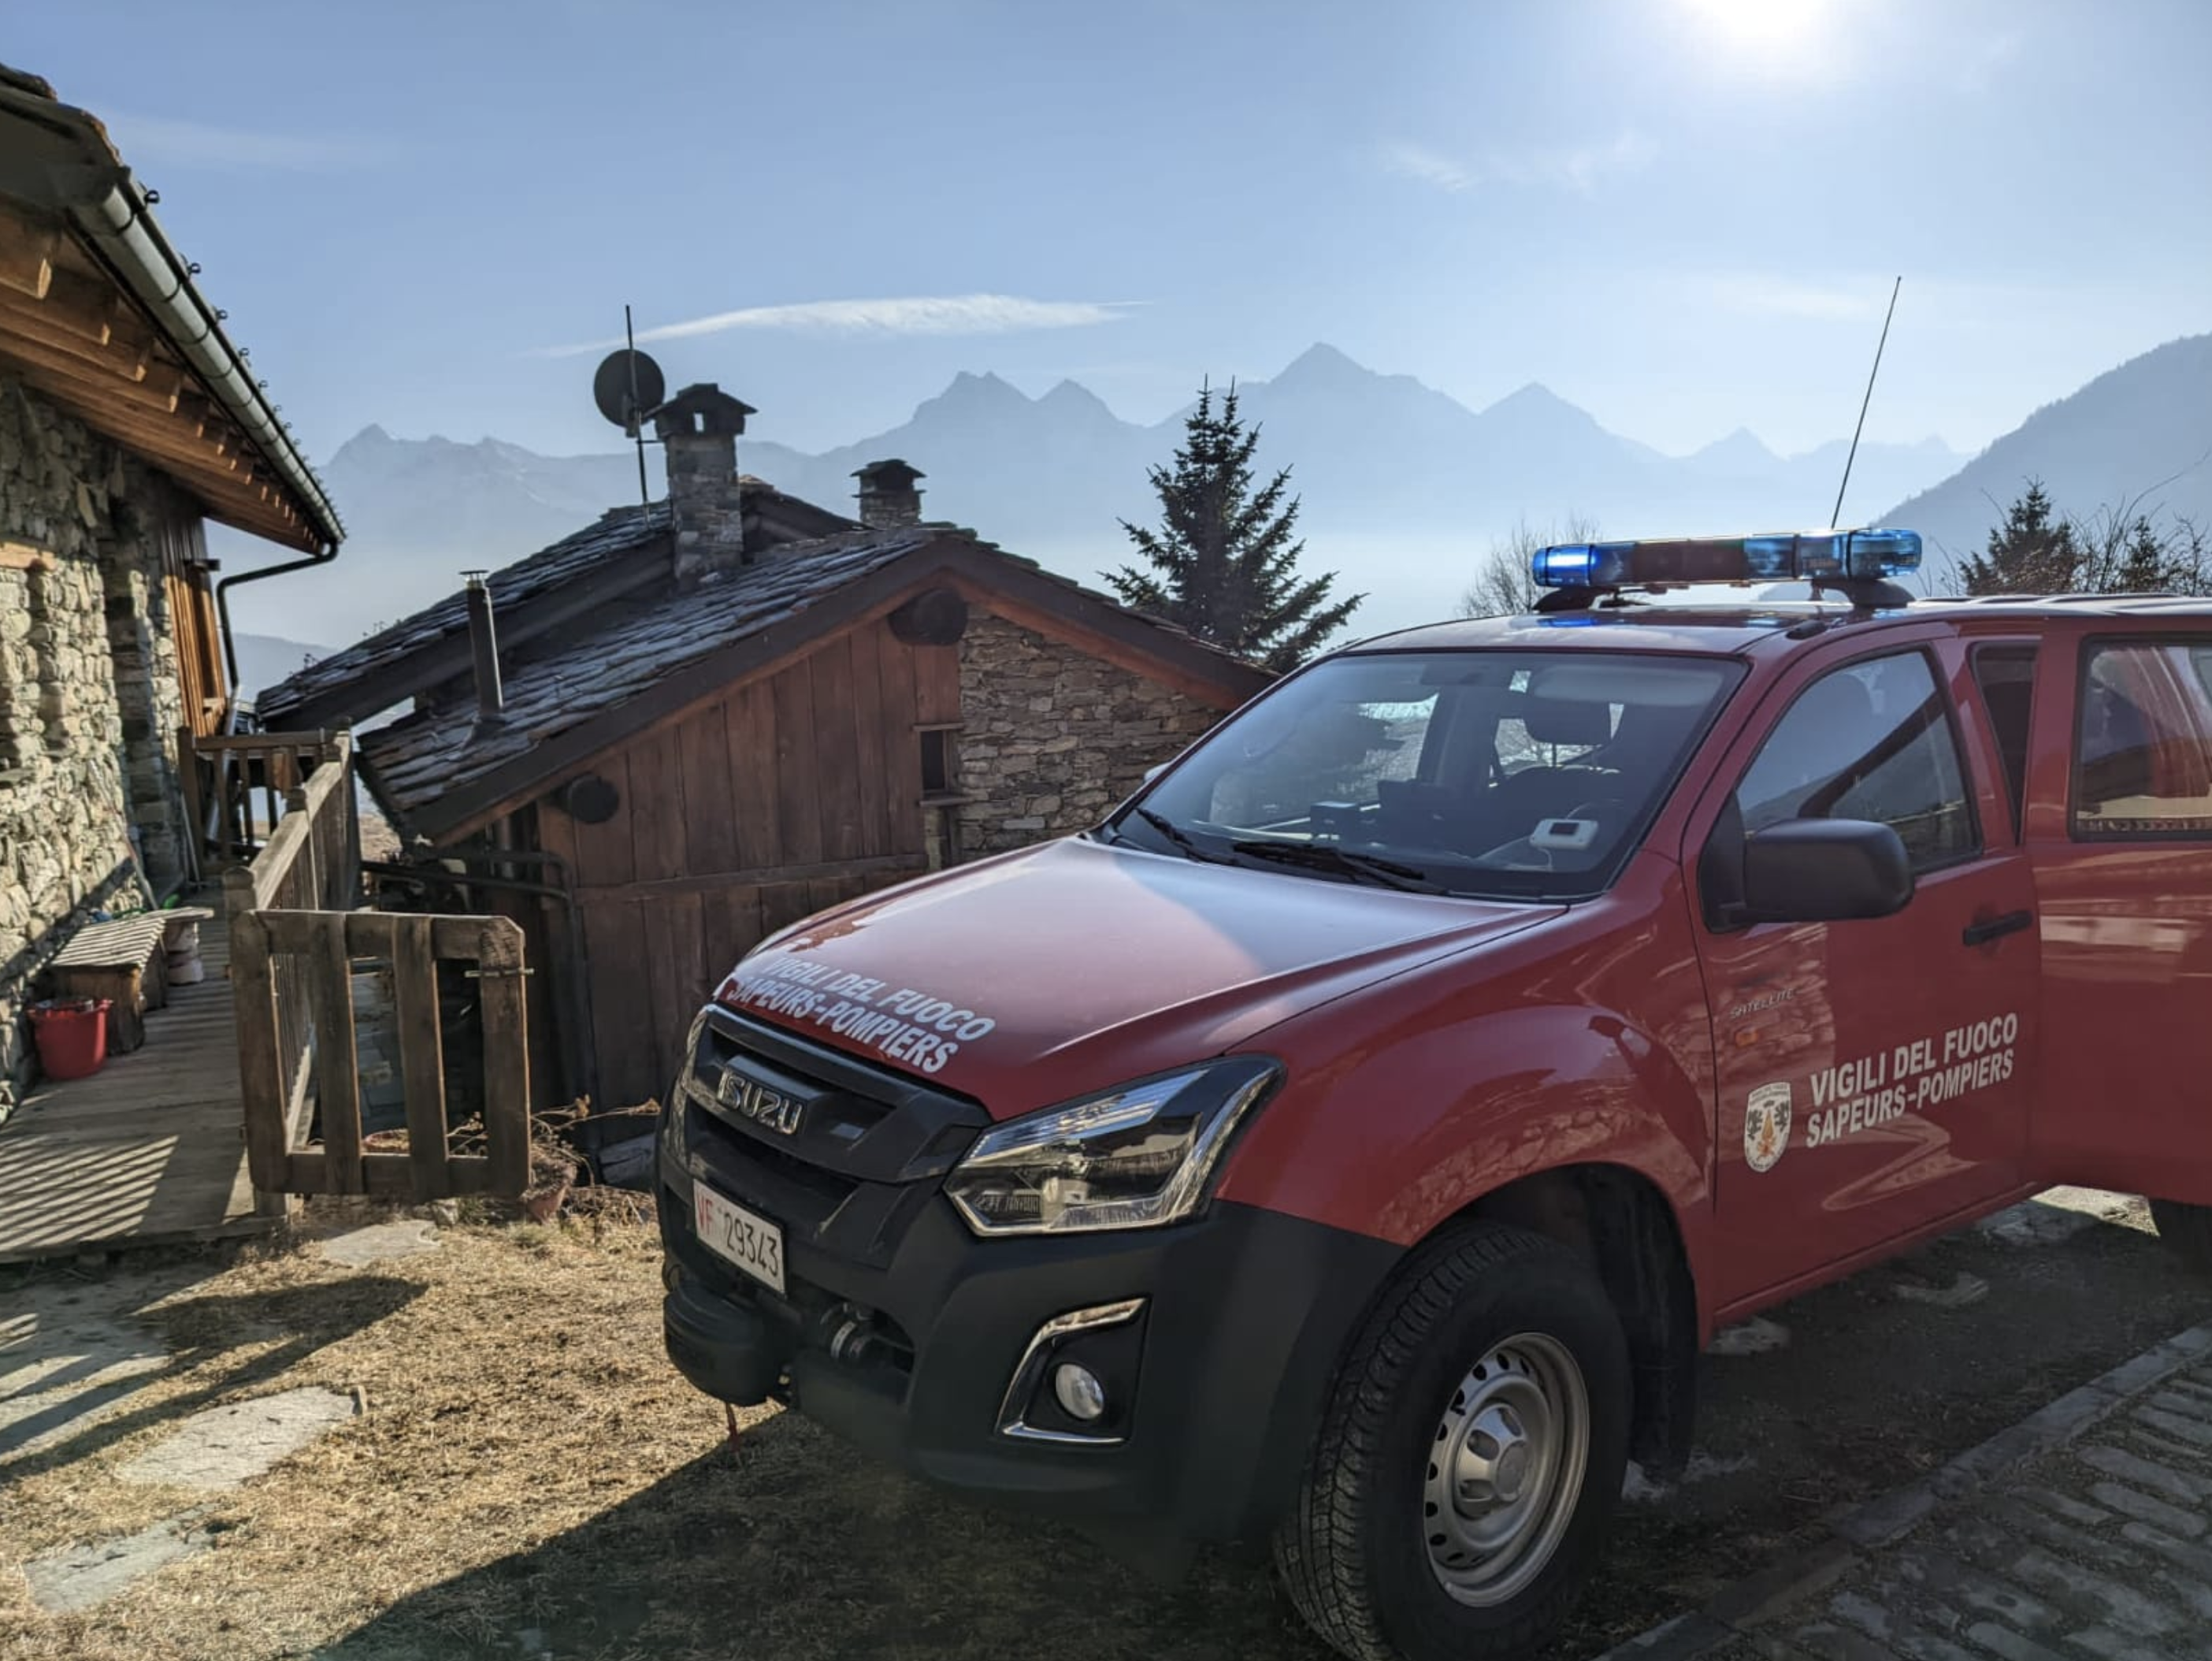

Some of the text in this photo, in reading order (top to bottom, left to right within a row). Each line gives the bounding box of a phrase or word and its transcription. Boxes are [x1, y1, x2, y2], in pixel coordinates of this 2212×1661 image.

[726, 978, 959, 1073] SAPEURS-POMPIERS
[825, 971, 889, 1001] DEL
[876, 988, 996, 1042] FUOCO
[718, 1068, 803, 1135] ISUZU
[1806, 1049, 2015, 1149] SAPEURS-POMPIERS
[1810, 1052, 1887, 1106] VIGILI
[1893, 1039, 1936, 1080] DEL
[1943, 1013, 2018, 1064] FUOCO
[697, 1193, 778, 1278] VF 29343
